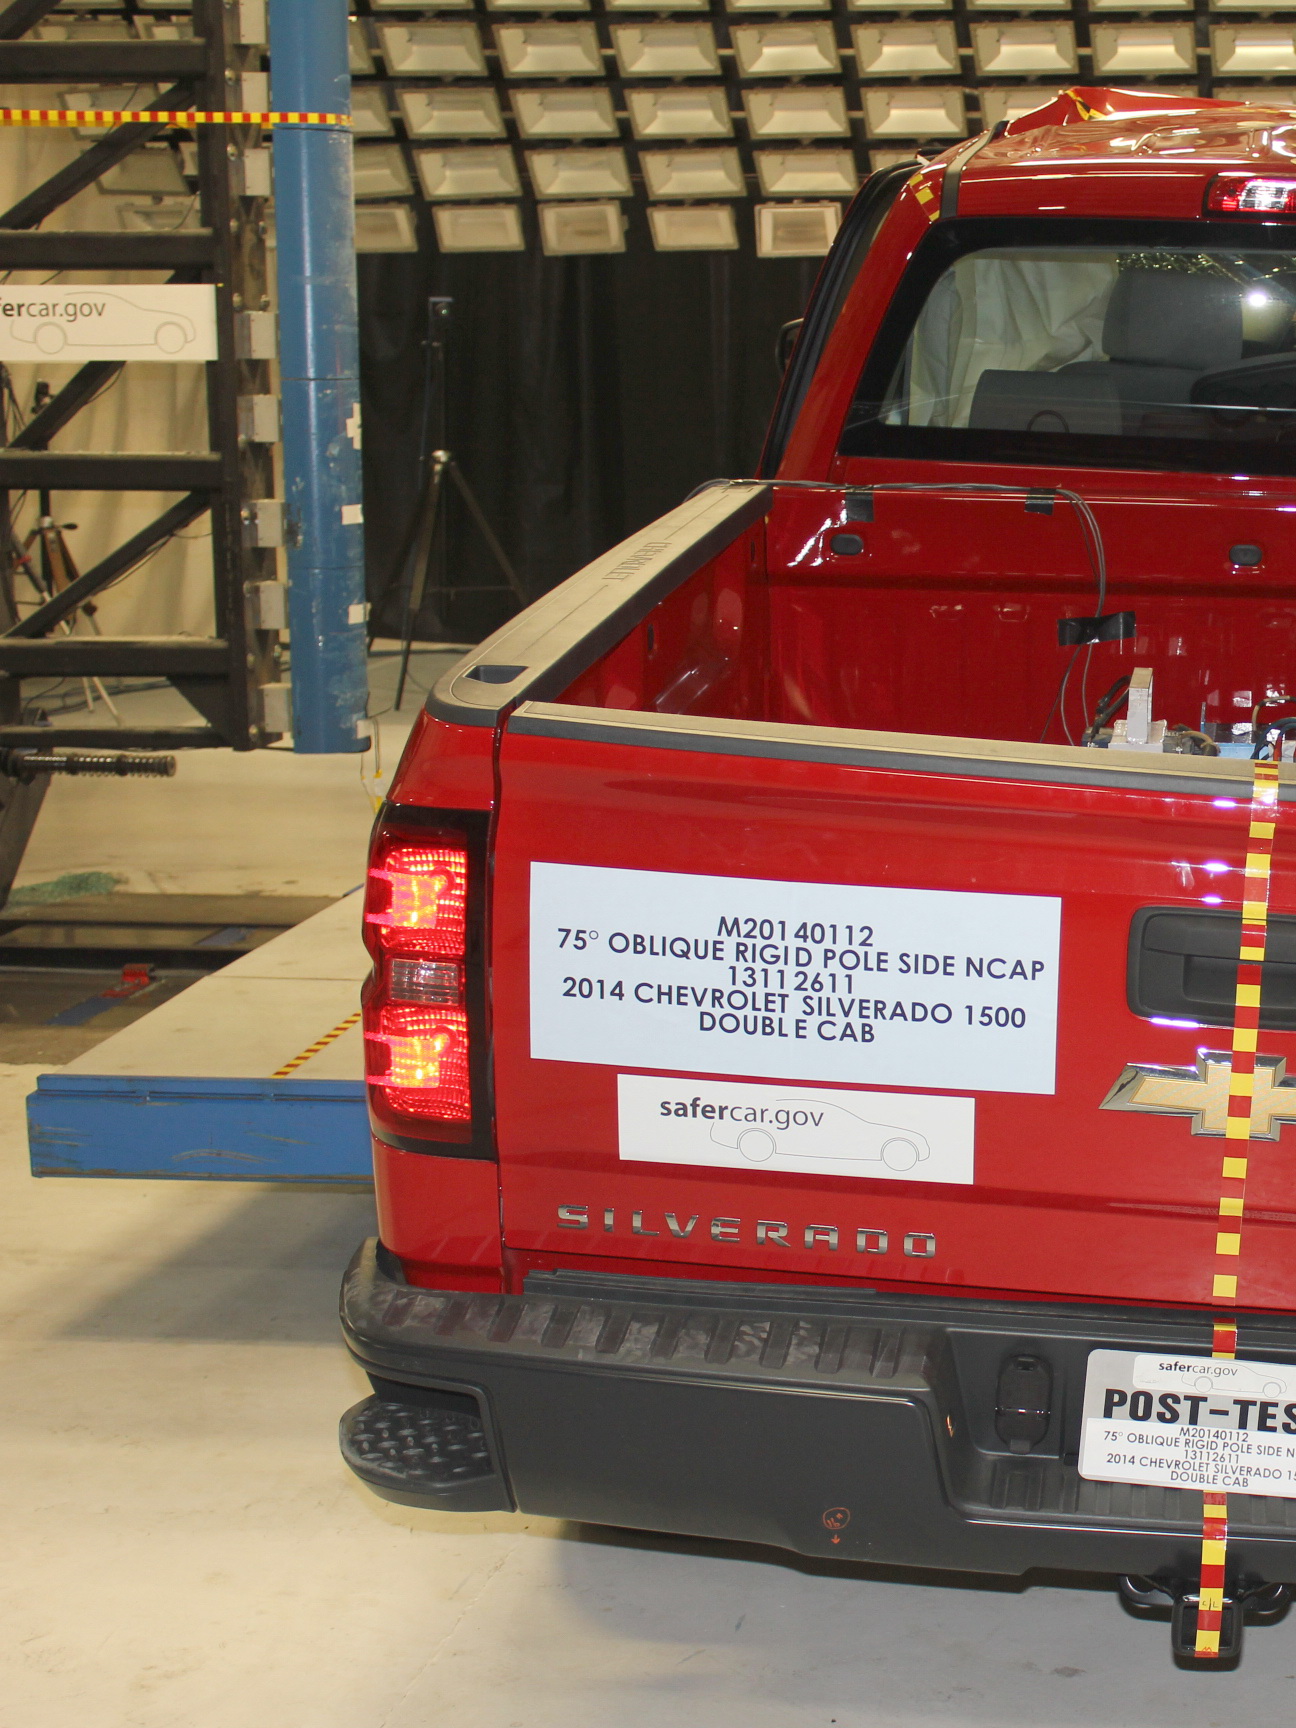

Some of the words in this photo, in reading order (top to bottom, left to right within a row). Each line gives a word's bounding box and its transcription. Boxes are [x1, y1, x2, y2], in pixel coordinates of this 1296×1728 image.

[0, 297, 106, 322] ercar.gov
[717, 916, 874, 947] M20140112
[557, 928, 599, 950] 75°
[608, 932, 725, 960] OBLIQUE
[735, 941, 812, 967] RIGID
[823, 948, 889, 972] POLE
[898, 952, 955, 976] SIDE
[965, 956, 1045, 981] NCAP
[728, 965, 853, 994] 13112611
[562, 976, 625, 1001] 2014
[634, 982, 789, 1014] CHEVROLET
[802, 995, 953, 1024] SILVERADO
[965, 1005, 1026, 1028] 1500
[699, 1011, 807, 1039] DOUBLE
[817, 1020, 875, 1043] CAB
[659, 1096, 824, 1130] safercar.gov
[556, 1204, 937, 1259] SILVERADO
[1158, 1360, 1238, 1378] safercar.gov
[1126, 1432, 1181, 1447] OBLIQUE
[1184, 1438, 1218, 1451] RIGID
[1222, 1442, 1253, 1454] POLE
[1256, 1445, 1282, 1457] SIDE
[1179, 1426, 1249, 1443] M20140112
[1106, 1452, 1135, 1465] 2014
[1139, 1456, 1210, 1473] CHEVROLET
[1213, 1462, 1283, 1480] SILVERADO
[1184, 1449, 1239, 1464] 13112611
[1170, 1470, 1218, 1485] DOUBLE
[1222, 1475, 1249, 1488] CAB
